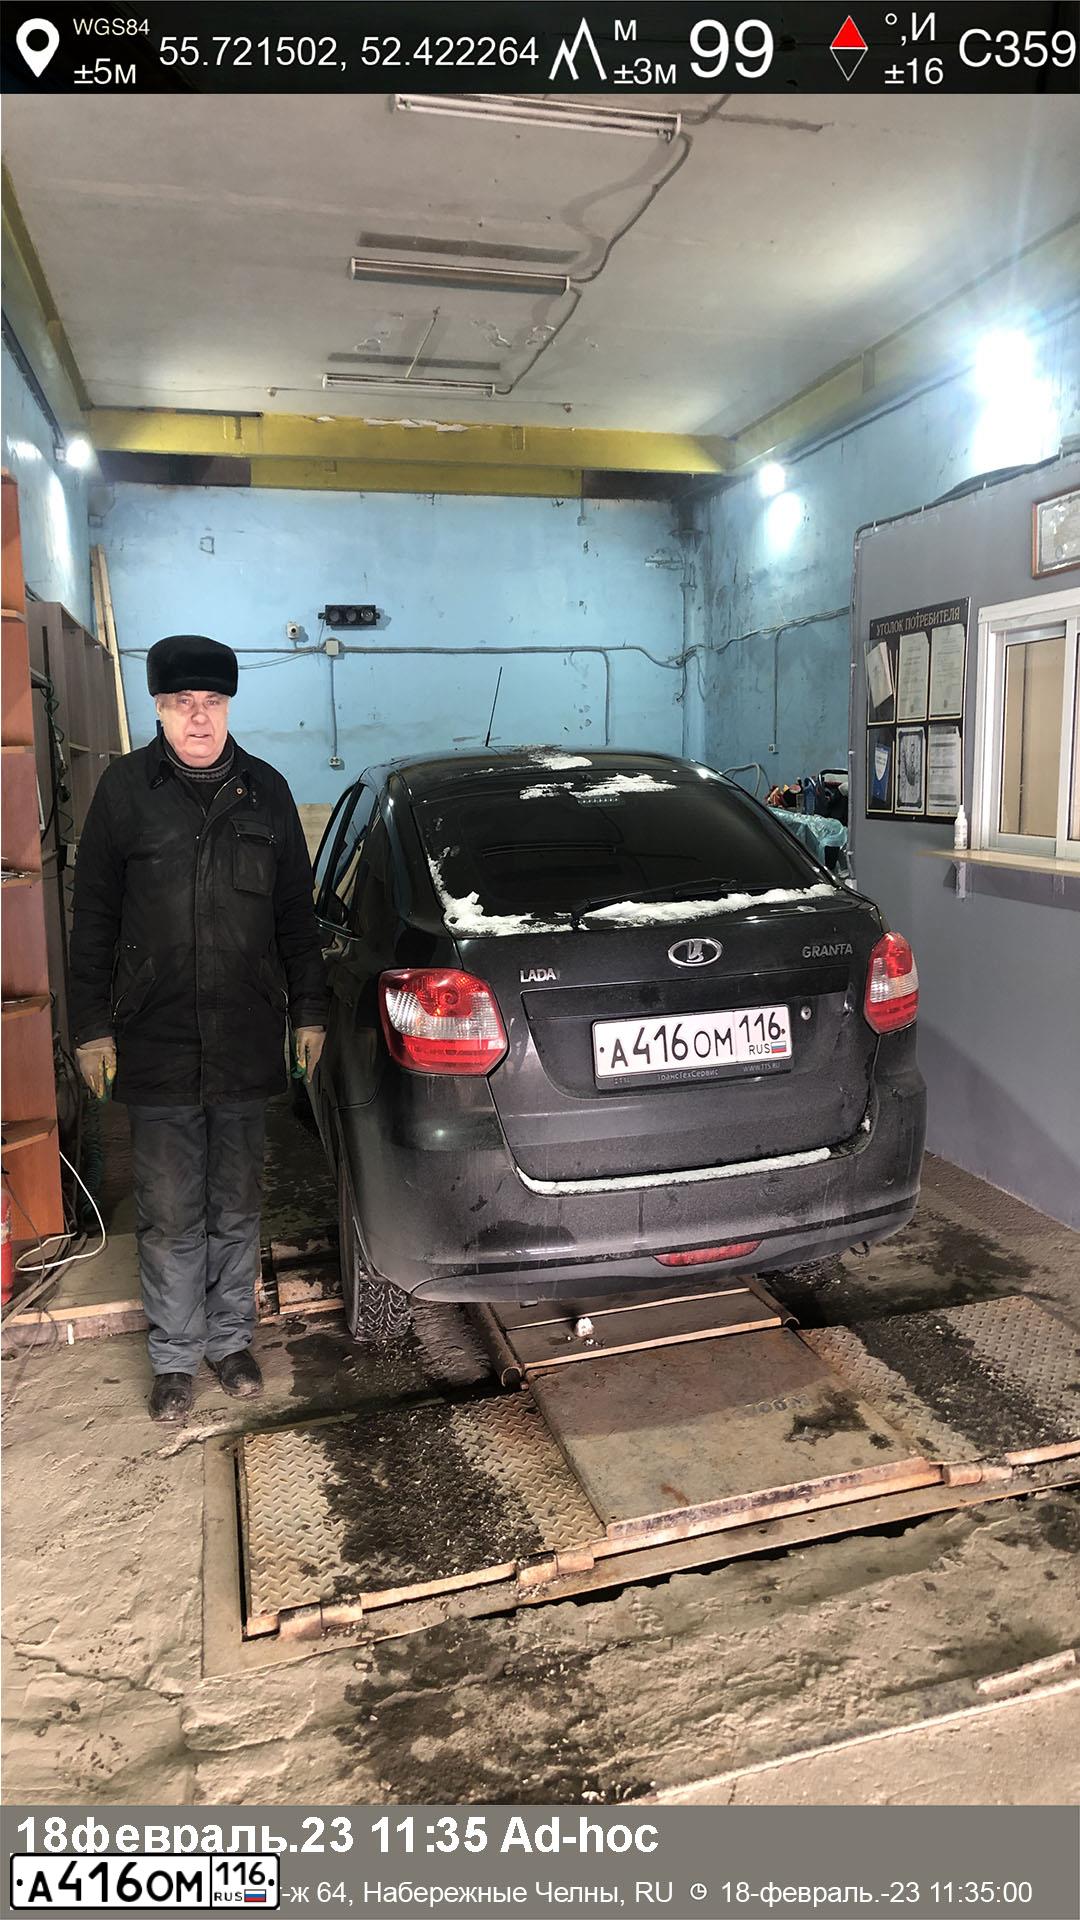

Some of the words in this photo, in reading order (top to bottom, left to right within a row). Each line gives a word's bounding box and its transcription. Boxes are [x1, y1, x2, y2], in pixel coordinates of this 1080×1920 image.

[876, 620, 904, 637] УГОЛОК
[905, 607, 960, 631] ПОТРЕБИТЕЛЯ
[802, 943, 853, 959] GRANTA
[520, 967, 557, 983] LADA
[739, 1011, 781, 1042] 116
[749, 1043, 770, 1055] RUS
